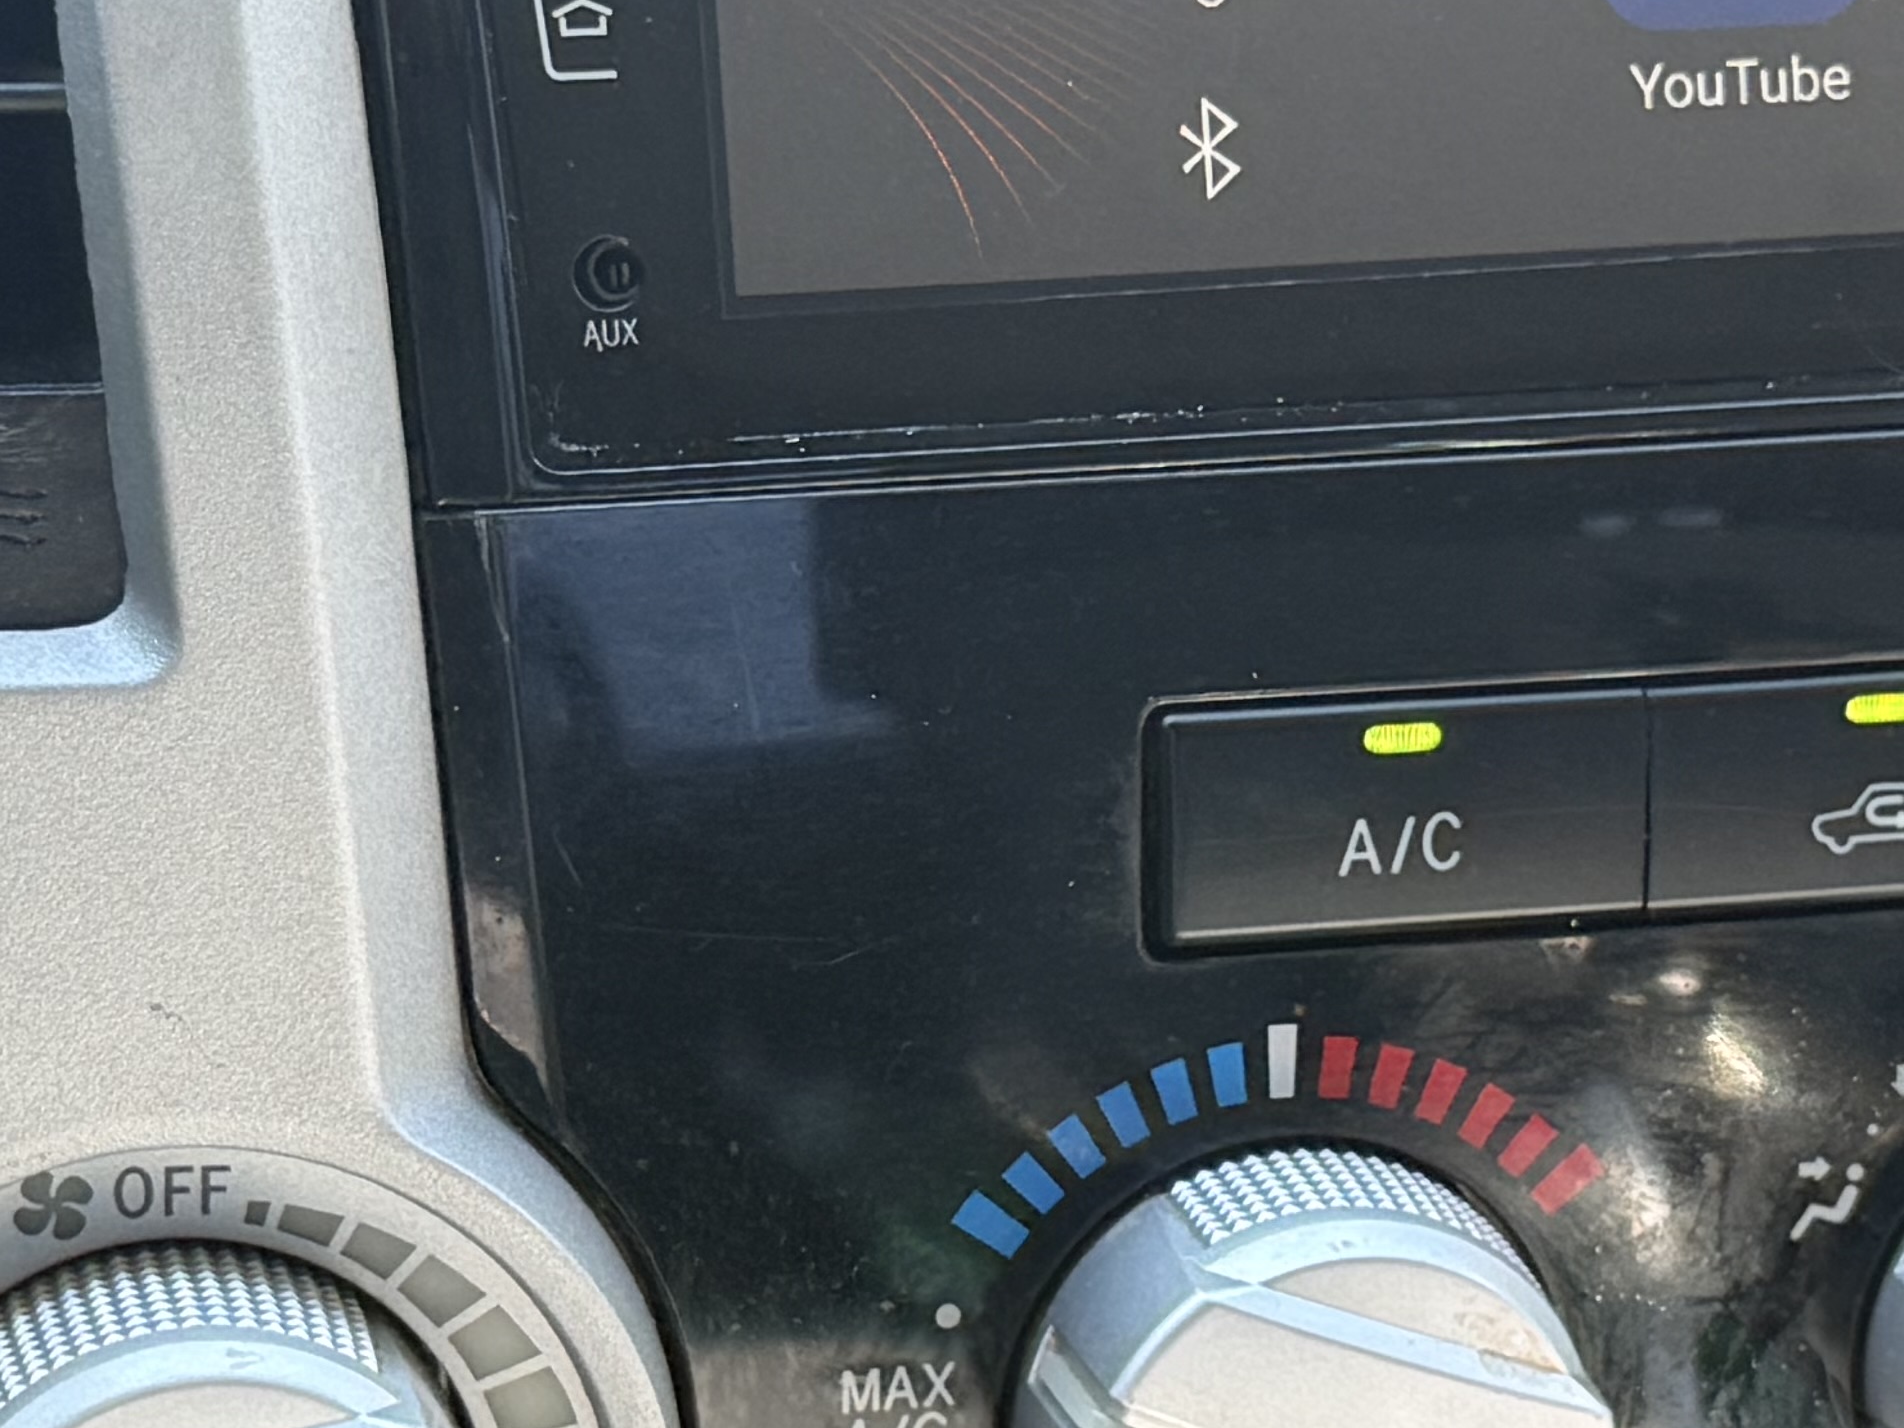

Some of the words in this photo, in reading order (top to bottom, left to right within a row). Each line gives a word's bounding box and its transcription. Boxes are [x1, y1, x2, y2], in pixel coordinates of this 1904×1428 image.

[1630, 55, 1851, 110] YouTube
[583, 318, 639, 351] AUX
[1339, 812, 1462, 877] A/C
[113, 1165, 231, 1219] OFF
[840, 1362, 957, 1414] MAX
